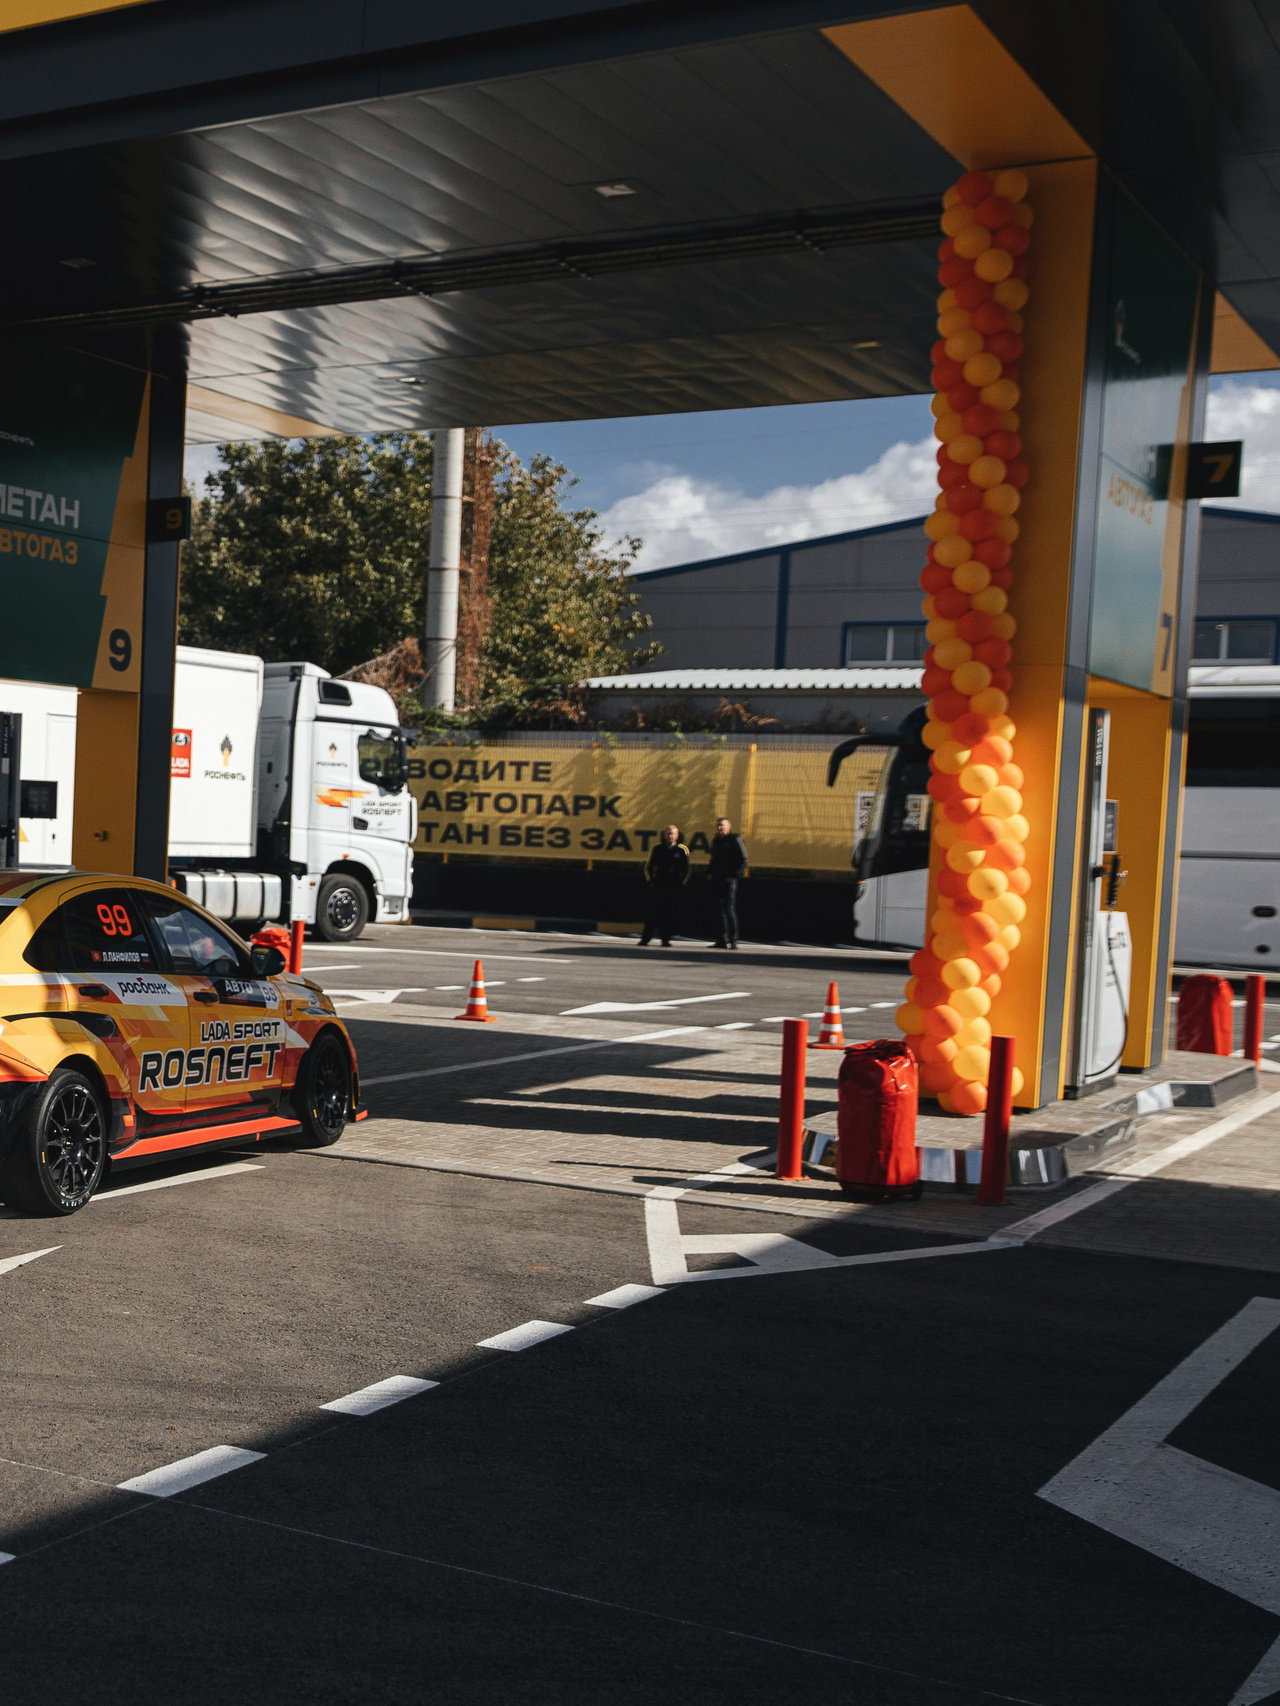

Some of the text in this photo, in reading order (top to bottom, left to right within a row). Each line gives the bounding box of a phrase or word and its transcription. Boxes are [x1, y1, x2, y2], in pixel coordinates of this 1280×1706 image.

[1203, 453, 1234, 483] 7
[165, 508, 183, 530] 9
[109, 628, 132, 672] 9
[171, 757, 190, 768] LADA
[204, 770, 246, 780] РОСНЕФТЬ
[420, 790, 623, 818] АВТОПАРК
[418, 821, 489, 845] ТАН
[499, 824, 571, 848] БЕЗ
[96, 904, 133, 936] 99
[117, 977, 171, 997] росбанк
[225, 980, 253, 993] АВТО
[262, 986, 278, 1002] 99
[200, 1021, 281, 1043] LADA SPORT
[138, 1042, 282, 1093] ROSNEFT
